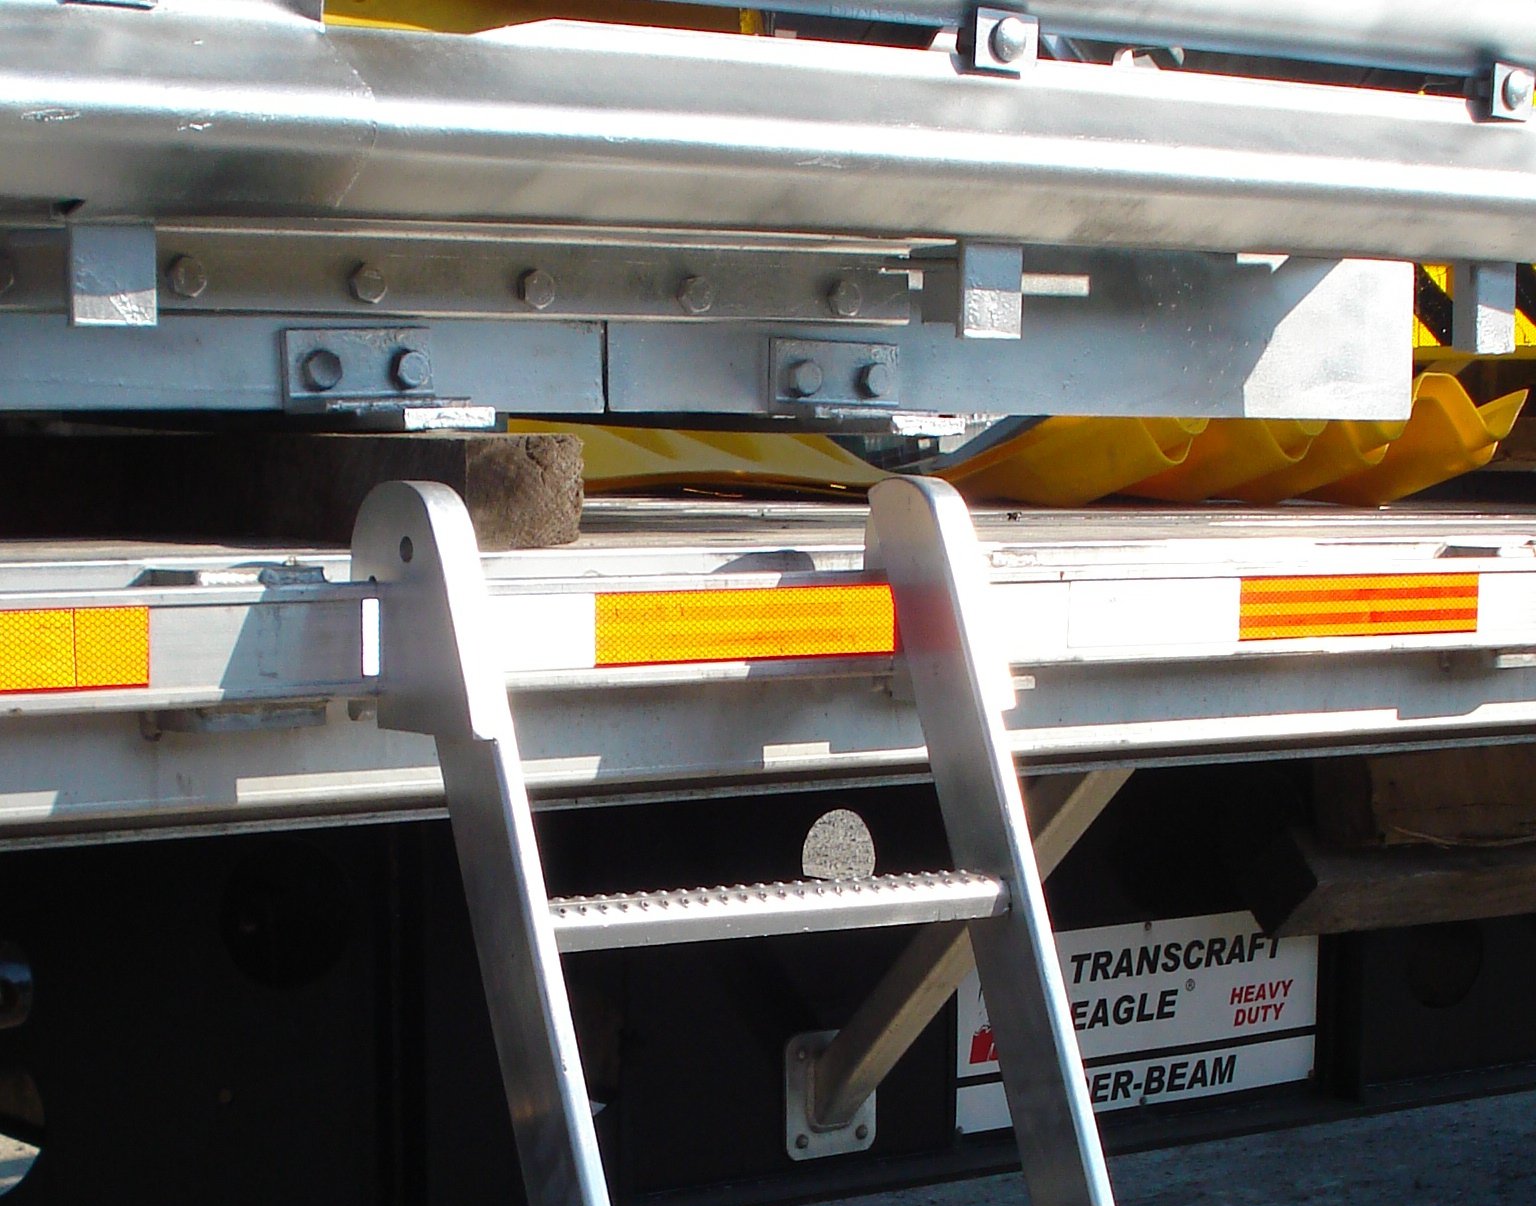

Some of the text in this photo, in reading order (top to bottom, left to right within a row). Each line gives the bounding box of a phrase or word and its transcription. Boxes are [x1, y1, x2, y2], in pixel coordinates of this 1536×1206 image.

[1070, 932, 1279, 984] TRANSCRAFT
[1229, 979, 1294, 1006] HEAVY
[1233, 1002, 1285, 1027] DUTY
[1086, 1054, 1237, 1103] ER-BEAM
